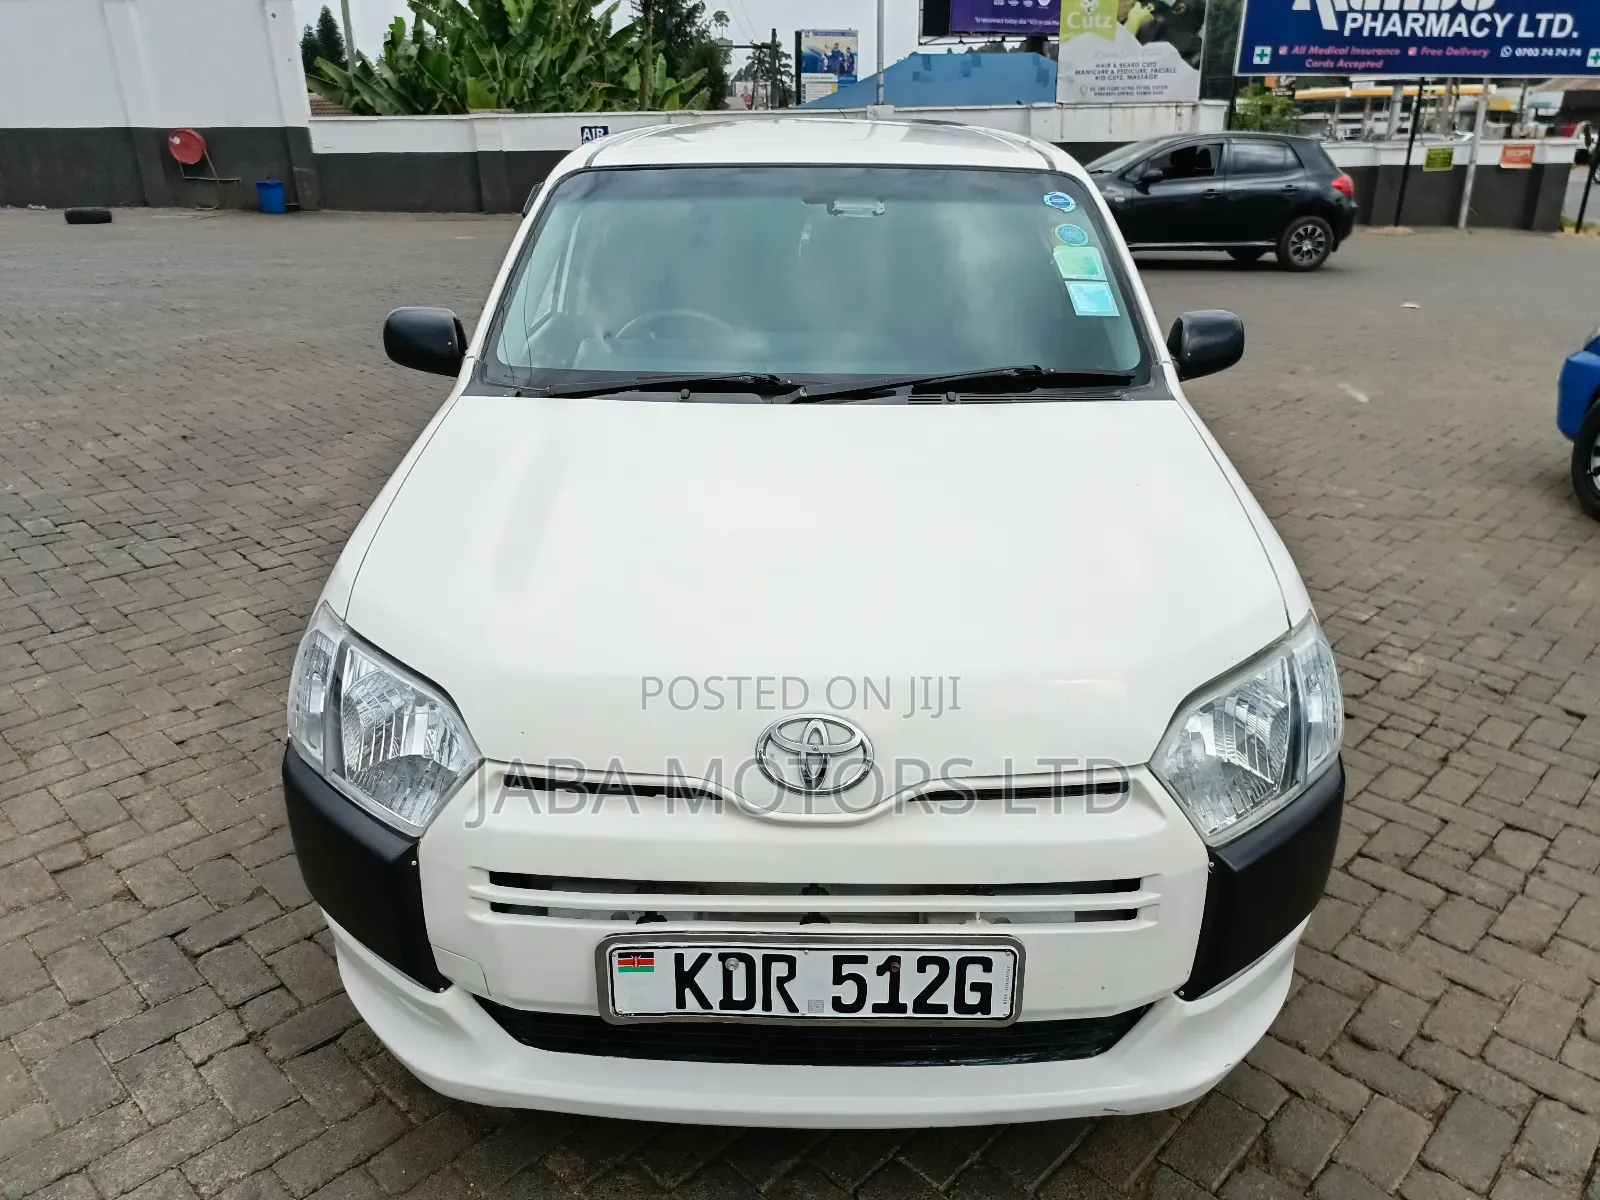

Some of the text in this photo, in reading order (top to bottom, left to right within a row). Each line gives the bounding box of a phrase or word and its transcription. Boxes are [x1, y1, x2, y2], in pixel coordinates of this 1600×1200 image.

[1066, 12, 1112, 29] Cutz
[1343, 13, 1580, 38] PHARMACY LTD.
[1291, 46, 1400, 55] All Medical Insurance
[1421, 46, 1491, 58] Free Delivery
[1305, 58, 1384, 70] Cards Accepted
[583, 128, 605, 140] AIR
[674, 952, 799, 1014] KDR
[831, 954, 993, 1016] 512G
